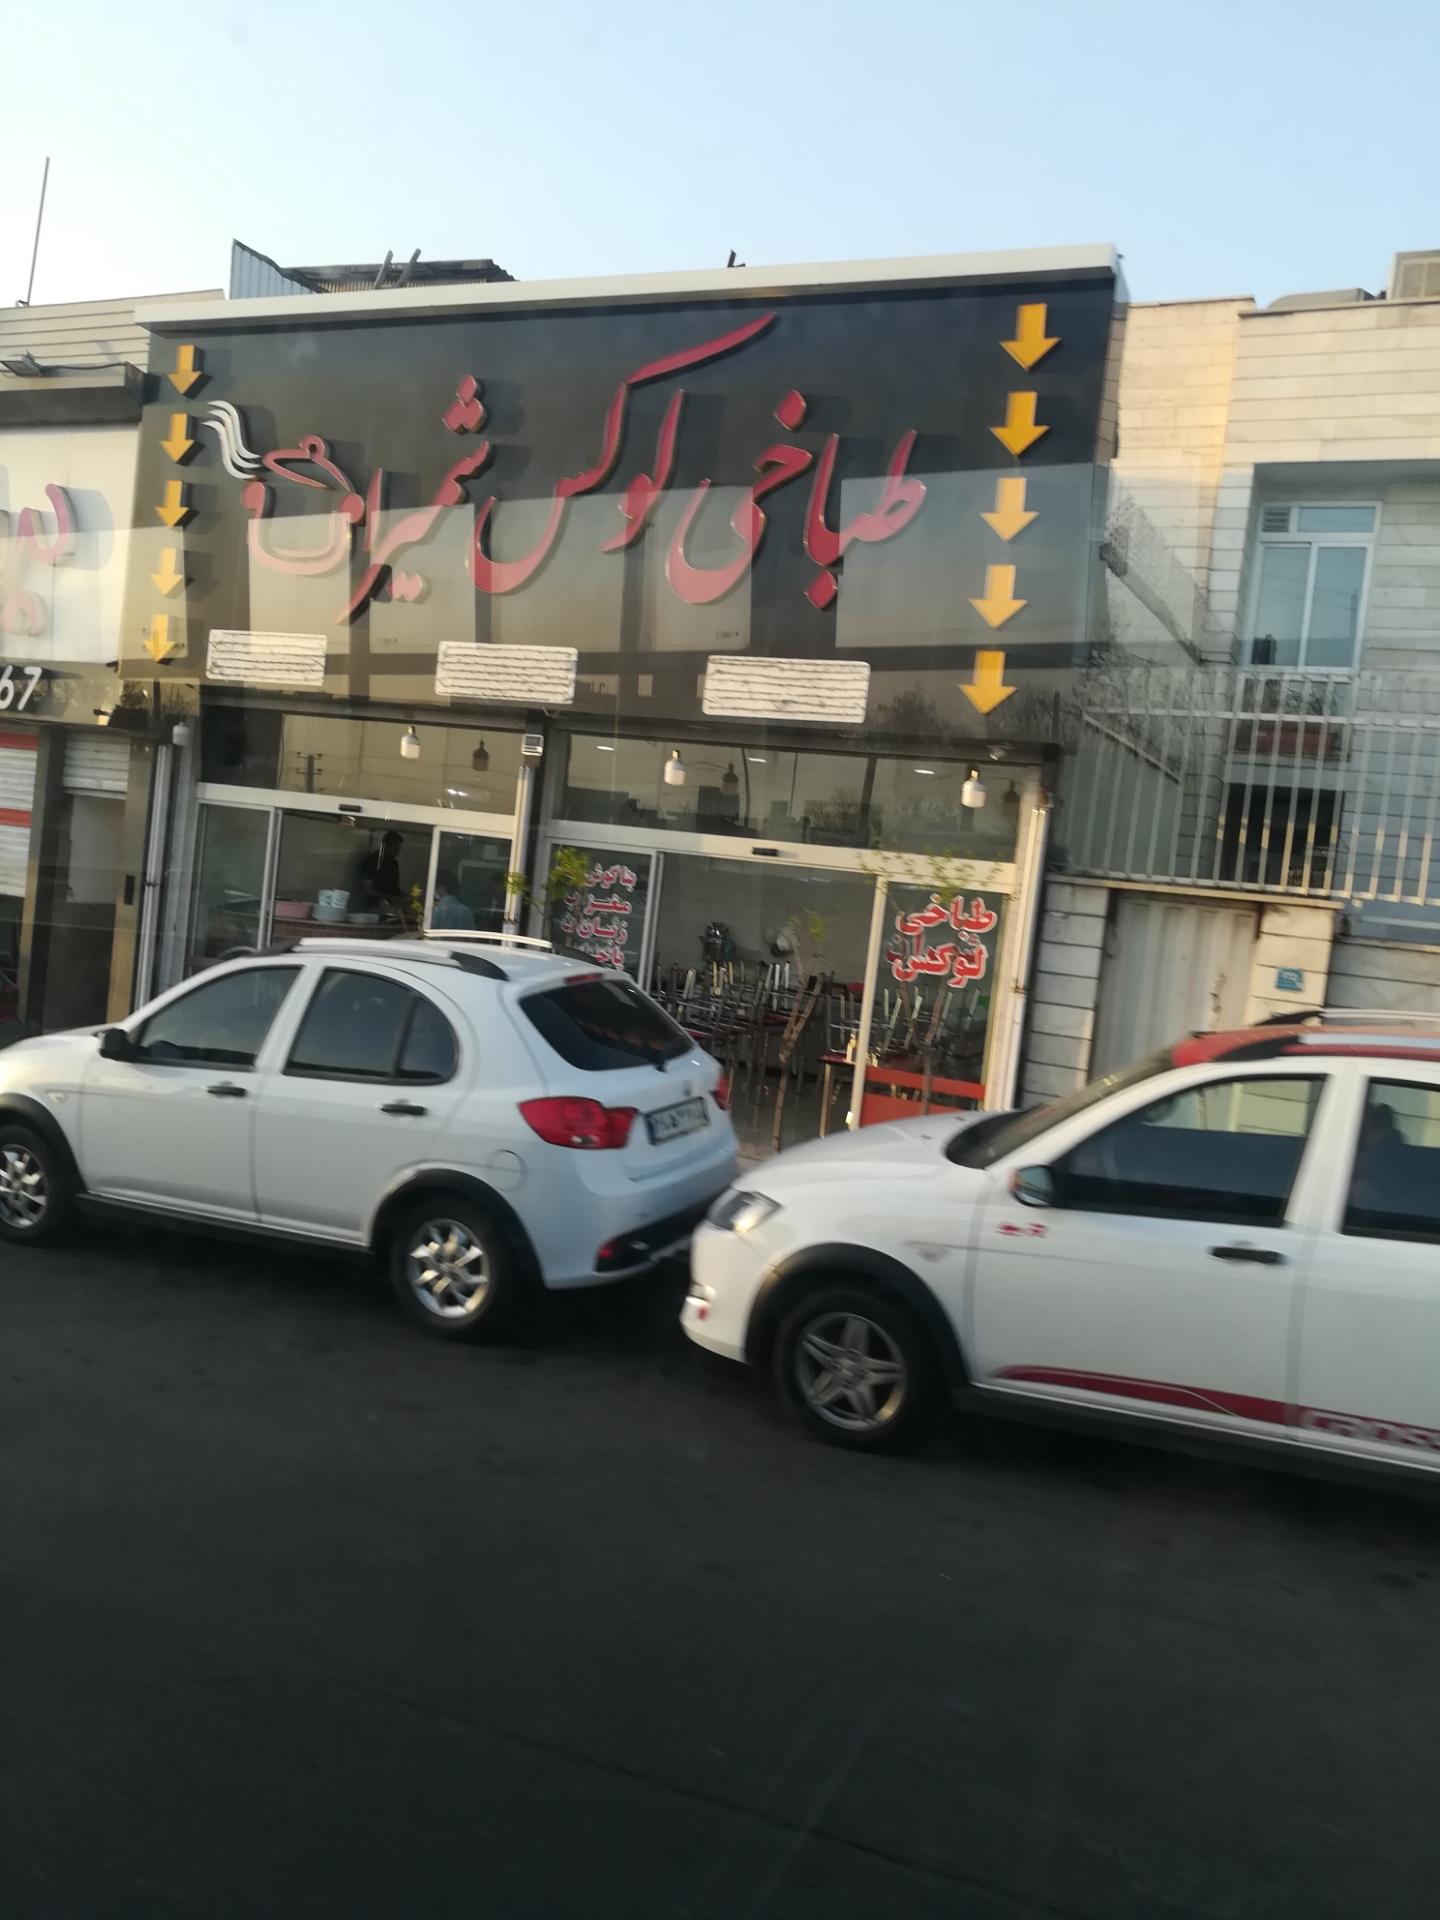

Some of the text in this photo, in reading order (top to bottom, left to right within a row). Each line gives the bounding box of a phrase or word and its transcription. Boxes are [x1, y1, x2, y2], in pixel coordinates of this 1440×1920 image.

[466, 311, 778, 597] لوکس
[665, 389, 928, 612] طباخی
[895, 893, 998, 941] طباخی
